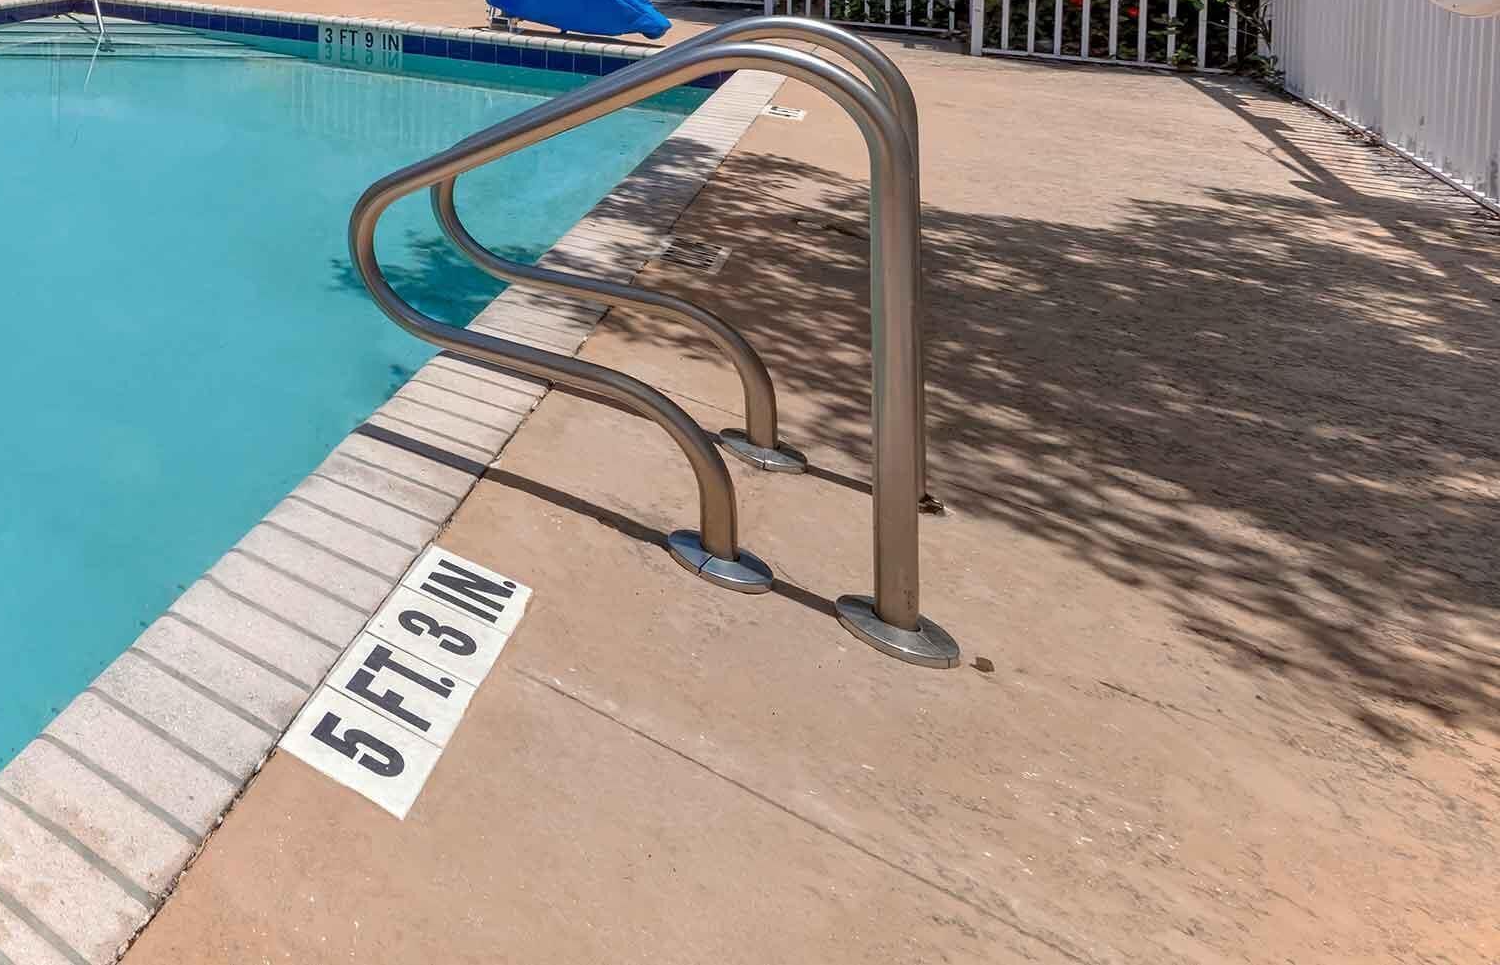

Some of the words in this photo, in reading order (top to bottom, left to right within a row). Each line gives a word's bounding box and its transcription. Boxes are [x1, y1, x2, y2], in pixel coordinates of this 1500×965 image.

[325, 28, 333, 44] 3
[340, 29, 358, 46] FT
[365, 32, 374, 48] 9
[382, 34, 400, 51] IN
[420, 559, 517, 624] IN.
[398, 610, 478, 656] 3
[345, 644, 456, 733] FT.
[311, 712, 405, 778] 5
